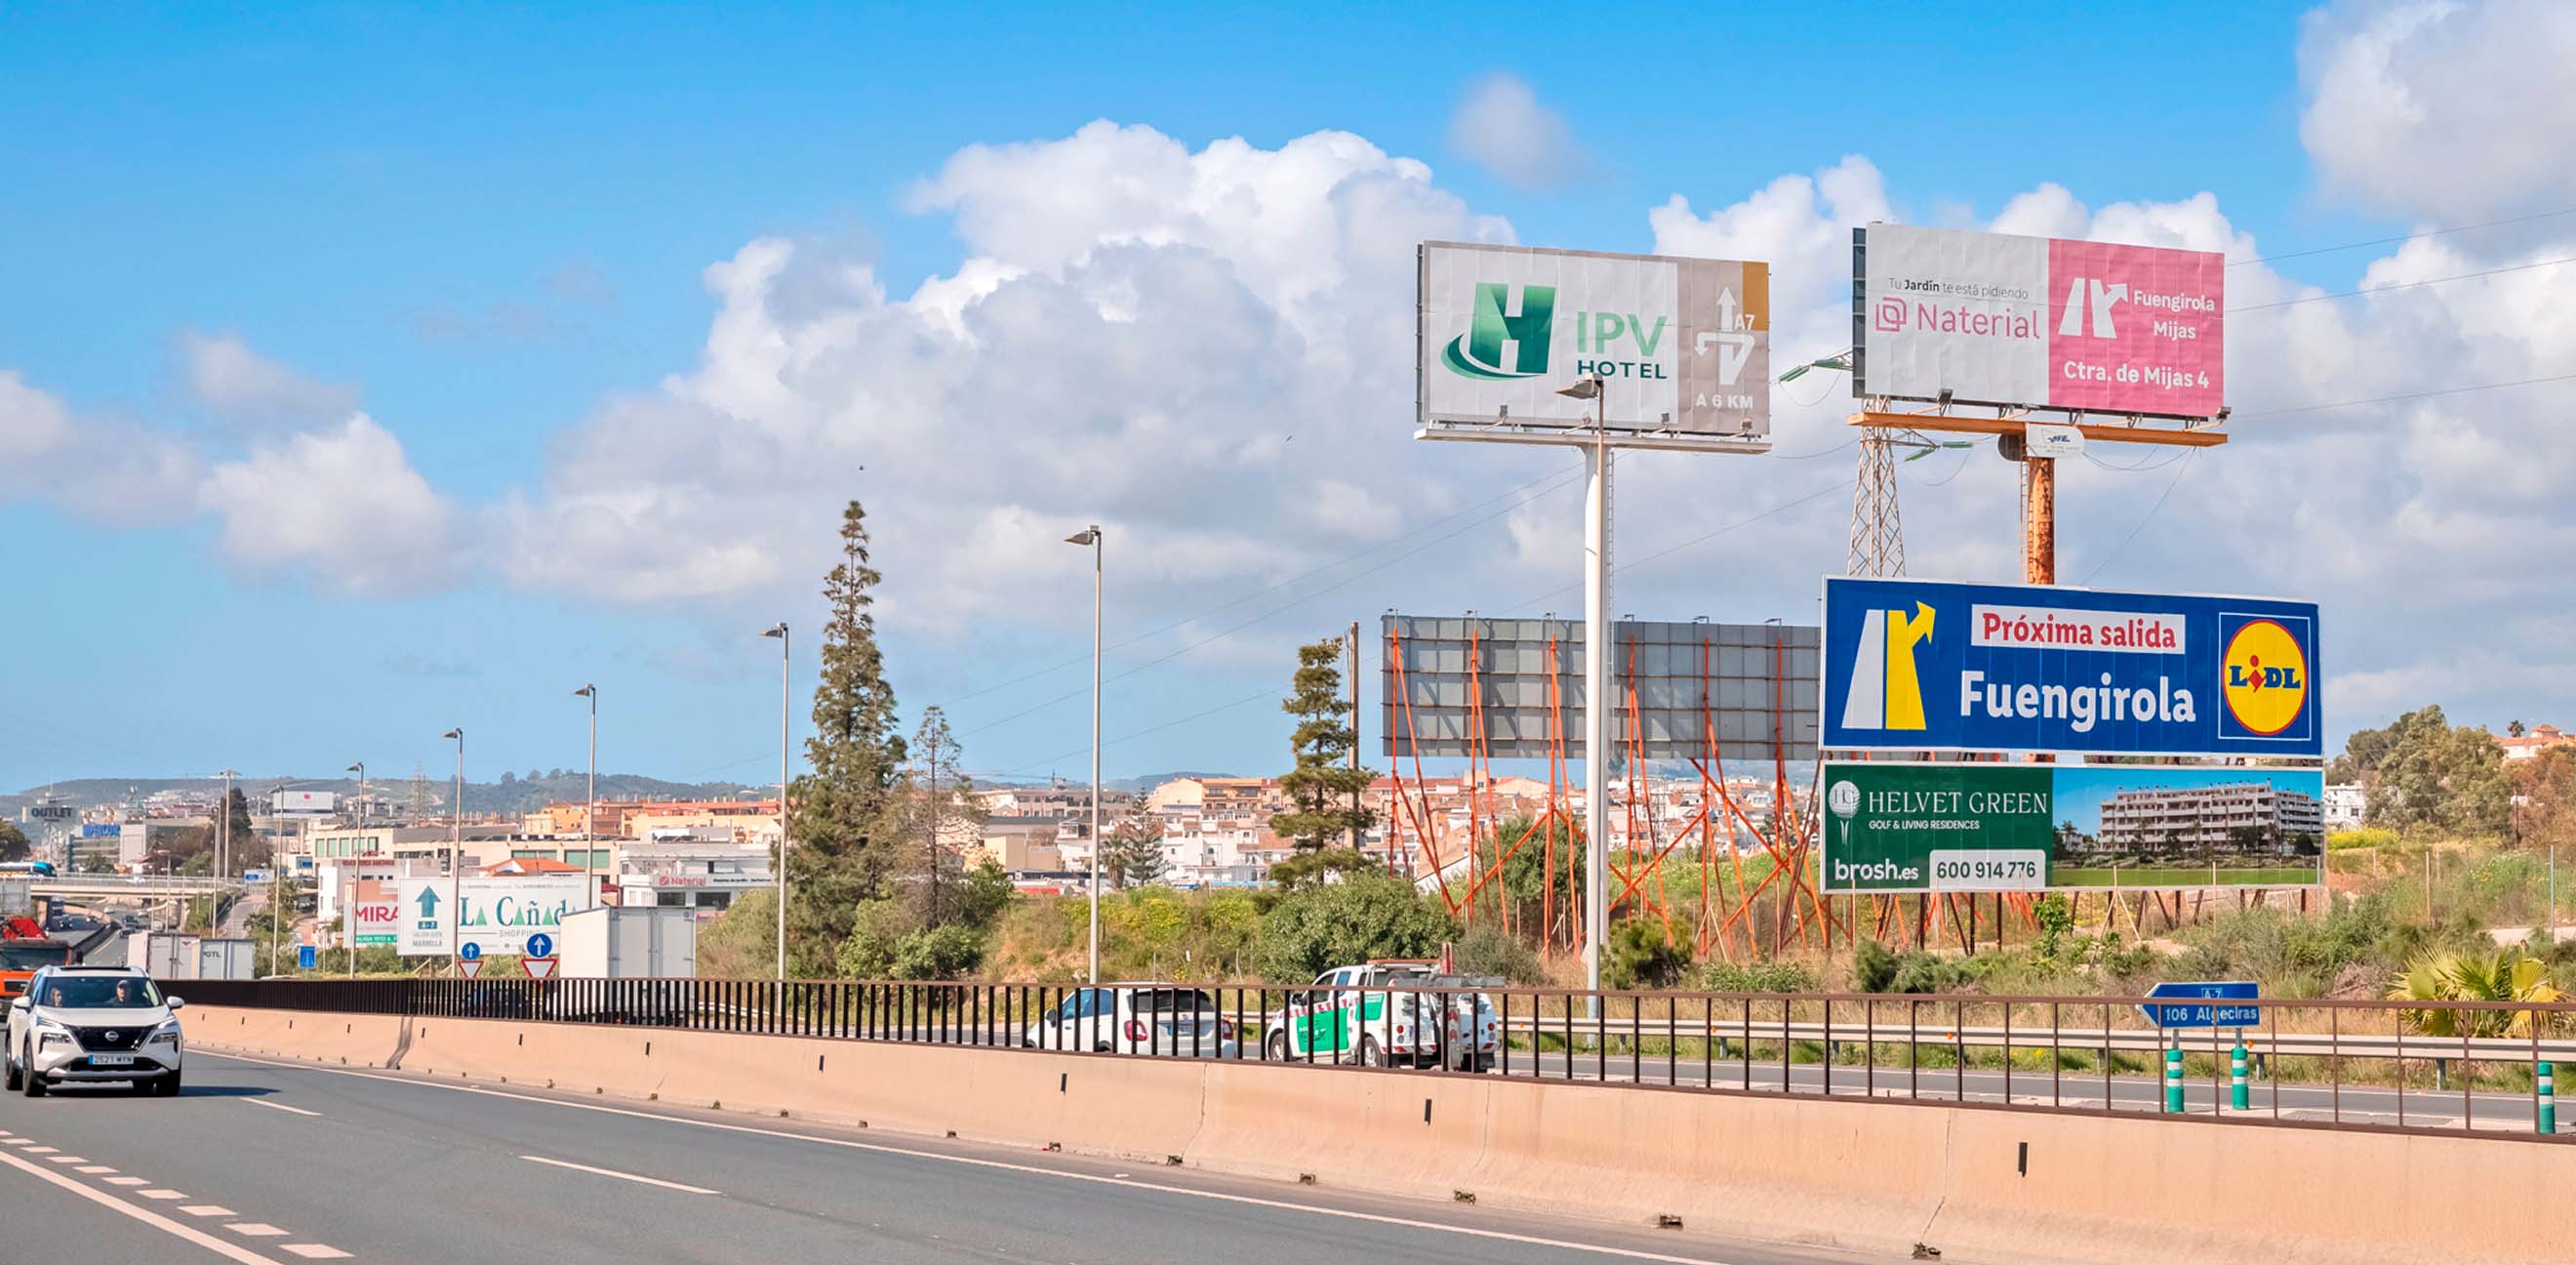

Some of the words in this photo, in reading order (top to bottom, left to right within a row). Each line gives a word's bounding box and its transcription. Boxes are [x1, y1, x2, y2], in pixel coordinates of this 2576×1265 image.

[1889, 278, 1903, 290] Tu
[1904, 278, 1940, 293] Jardín
[1943, 283, 1953, 294] te
[1955, 283, 1979, 296] está
[1982, 285, 2029, 301] pidiendo
[2134, 290, 2215, 312] Fuengirola
[1734, 314, 1755, 331] A7
[1917, 303, 2040, 340] Naterial
[2153, 320, 2196, 342] Mijas
[1577, 311, 1668, 357] IPV
[1577, 359, 1668, 380] HOTEL
[2064, 360, 2113, 382] Ctra.
[2115, 363, 2140, 384] de
[2144, 366, 2194, 390] Mijas
[2197, 370, 2210, 388] 4
[1695, 392, 1708, 408] A
[1712, 393, 1722, 408] 6
[1727, 394, 1754, 410] KM
[1982, 612, 2094, 647] Próxima
[2100, 619, 2177, 649] salida
[1960, 671, 2196, 733] Fuengirola
[31, 807, 73, 818] OUTLET
[1869, 792, 1962, 814] HELVET
[1968, 792, 2048, 814] GREEN
[1869, 820, 1892, 830] GOLF
[1893, 821, 1900, 830] &
[1902, 820, 1929, 830] LIVING
[1930, 820, 1981, 830] RESIDENCES
[1834, 858, 1919, 880] brosh.es
[1937, 862, 1970, 878] 600
[1975, 862, 2004, 878] 914
[2007, 861, 2036, 877] 776
[671, 877, 706, 885] Naterial
[2165, 1007, 2189, 1021] 106
